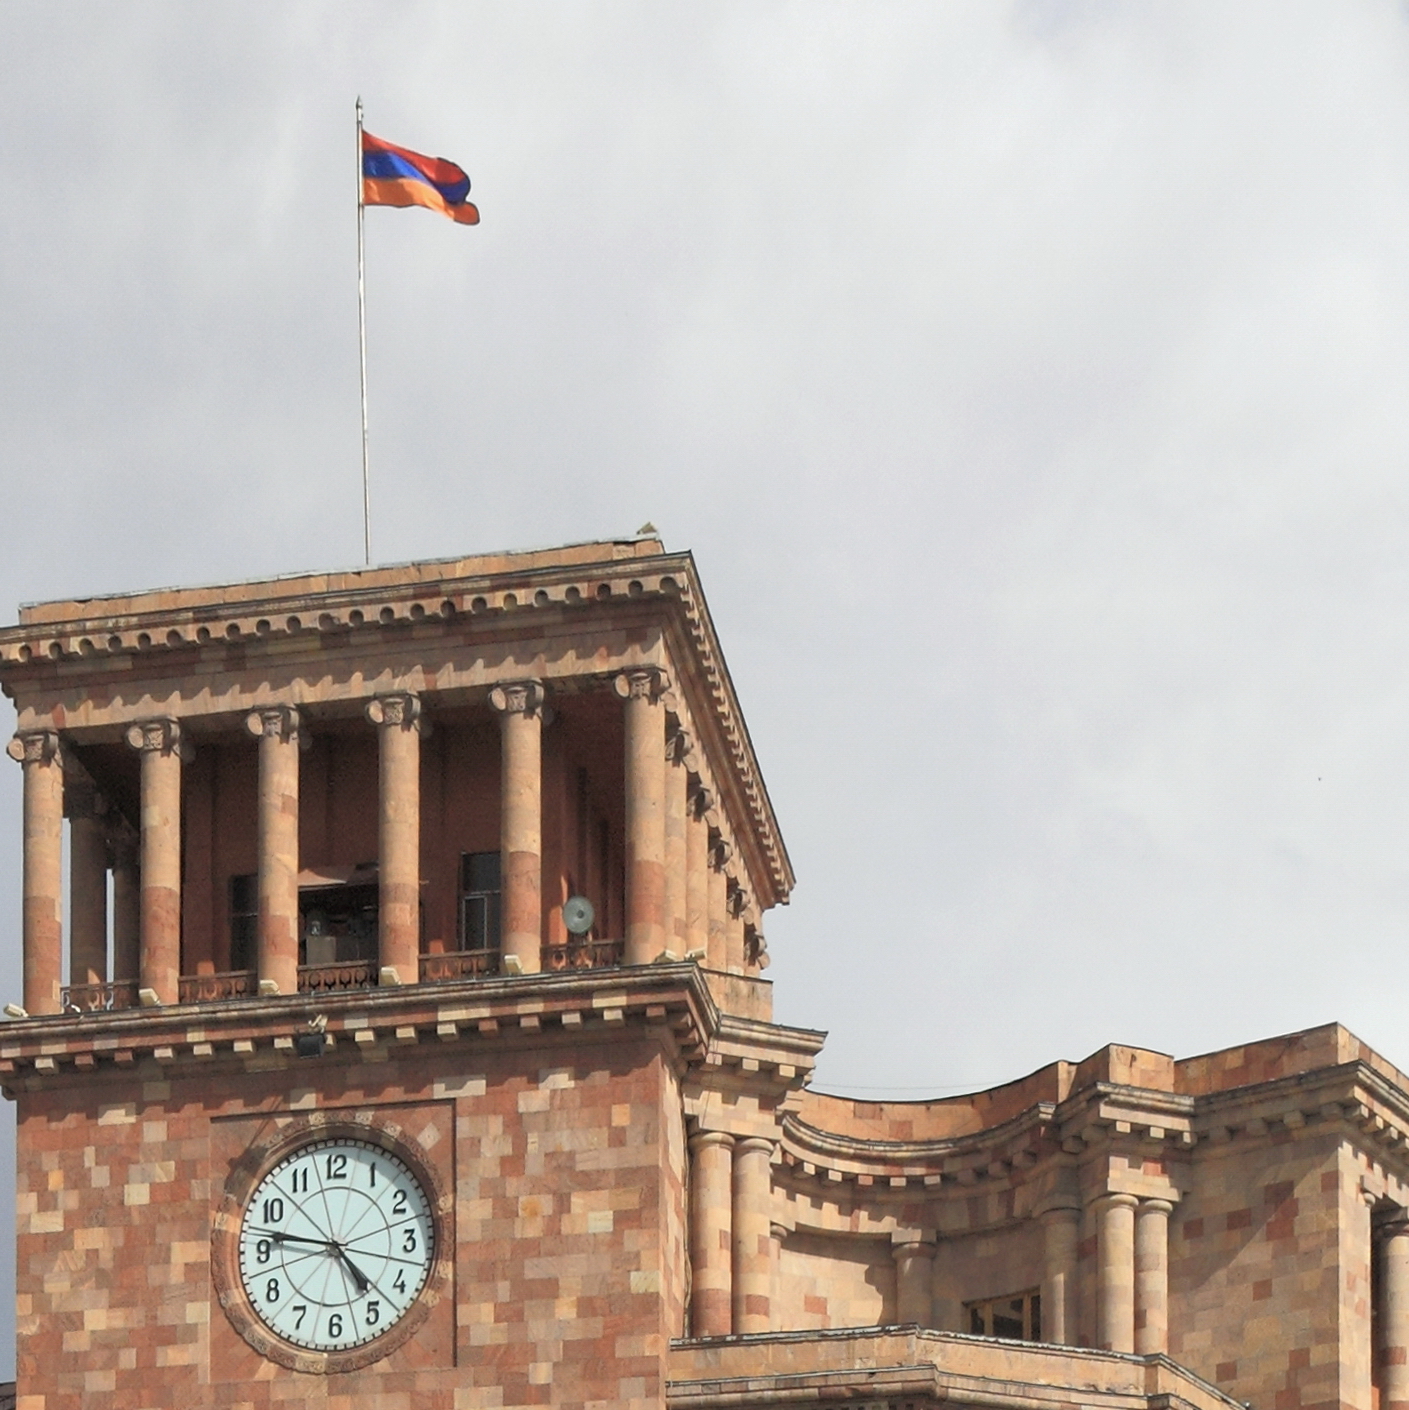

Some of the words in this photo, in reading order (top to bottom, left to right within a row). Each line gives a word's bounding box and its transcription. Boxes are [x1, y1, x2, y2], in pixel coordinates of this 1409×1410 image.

[326, 1154, 347, 1179] 12
[369, 1162, 376, 1187] 1
[292, 1168, 308, 1193] 11
[263, 1198, 284, 1223] 10
[393, 1190, 407, 1214] 2
[256, 1240, 270, 1264] 9
[403, 1229, 416, 1253] 3
[266, 1278, 279, 1302] 8
[393, 1269, 406, 1294] 4
[292, 1305, 306, 1330] 7
[366, 1301, 380, 1325] 5
[328, 1314, 342, 1337] 6
